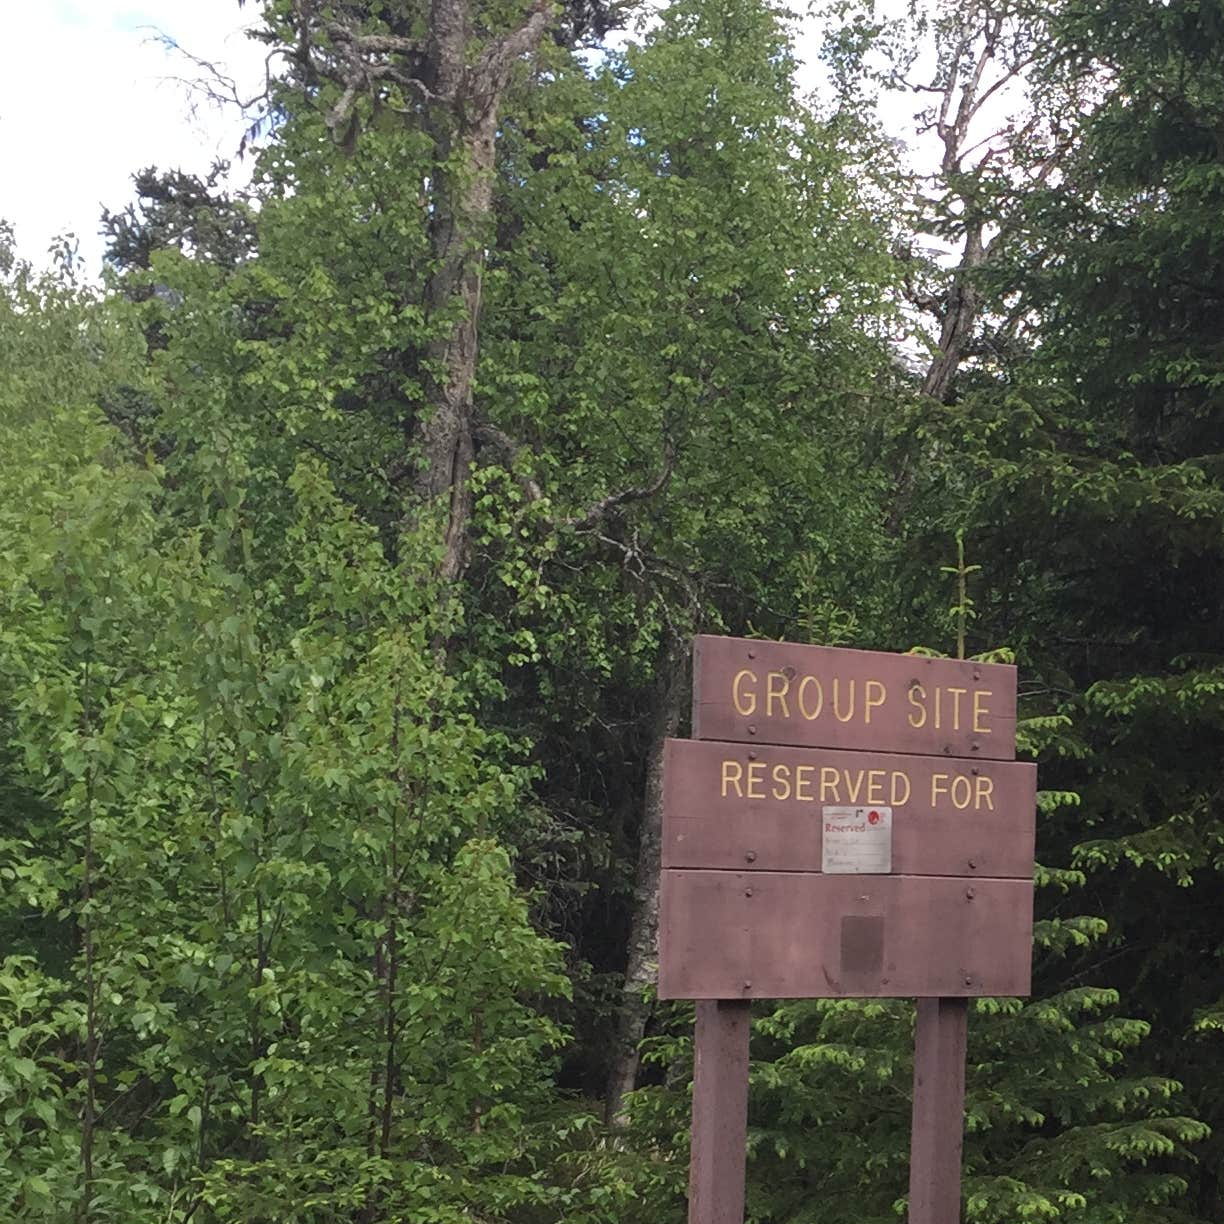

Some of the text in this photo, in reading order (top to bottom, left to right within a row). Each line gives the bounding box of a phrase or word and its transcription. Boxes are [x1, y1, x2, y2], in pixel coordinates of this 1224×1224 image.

[732, 669, 993, 733] GROUP SITE
[721, 760, 994, 811] RESERVED FOR
[825, 823, 866, 832] Reserved
